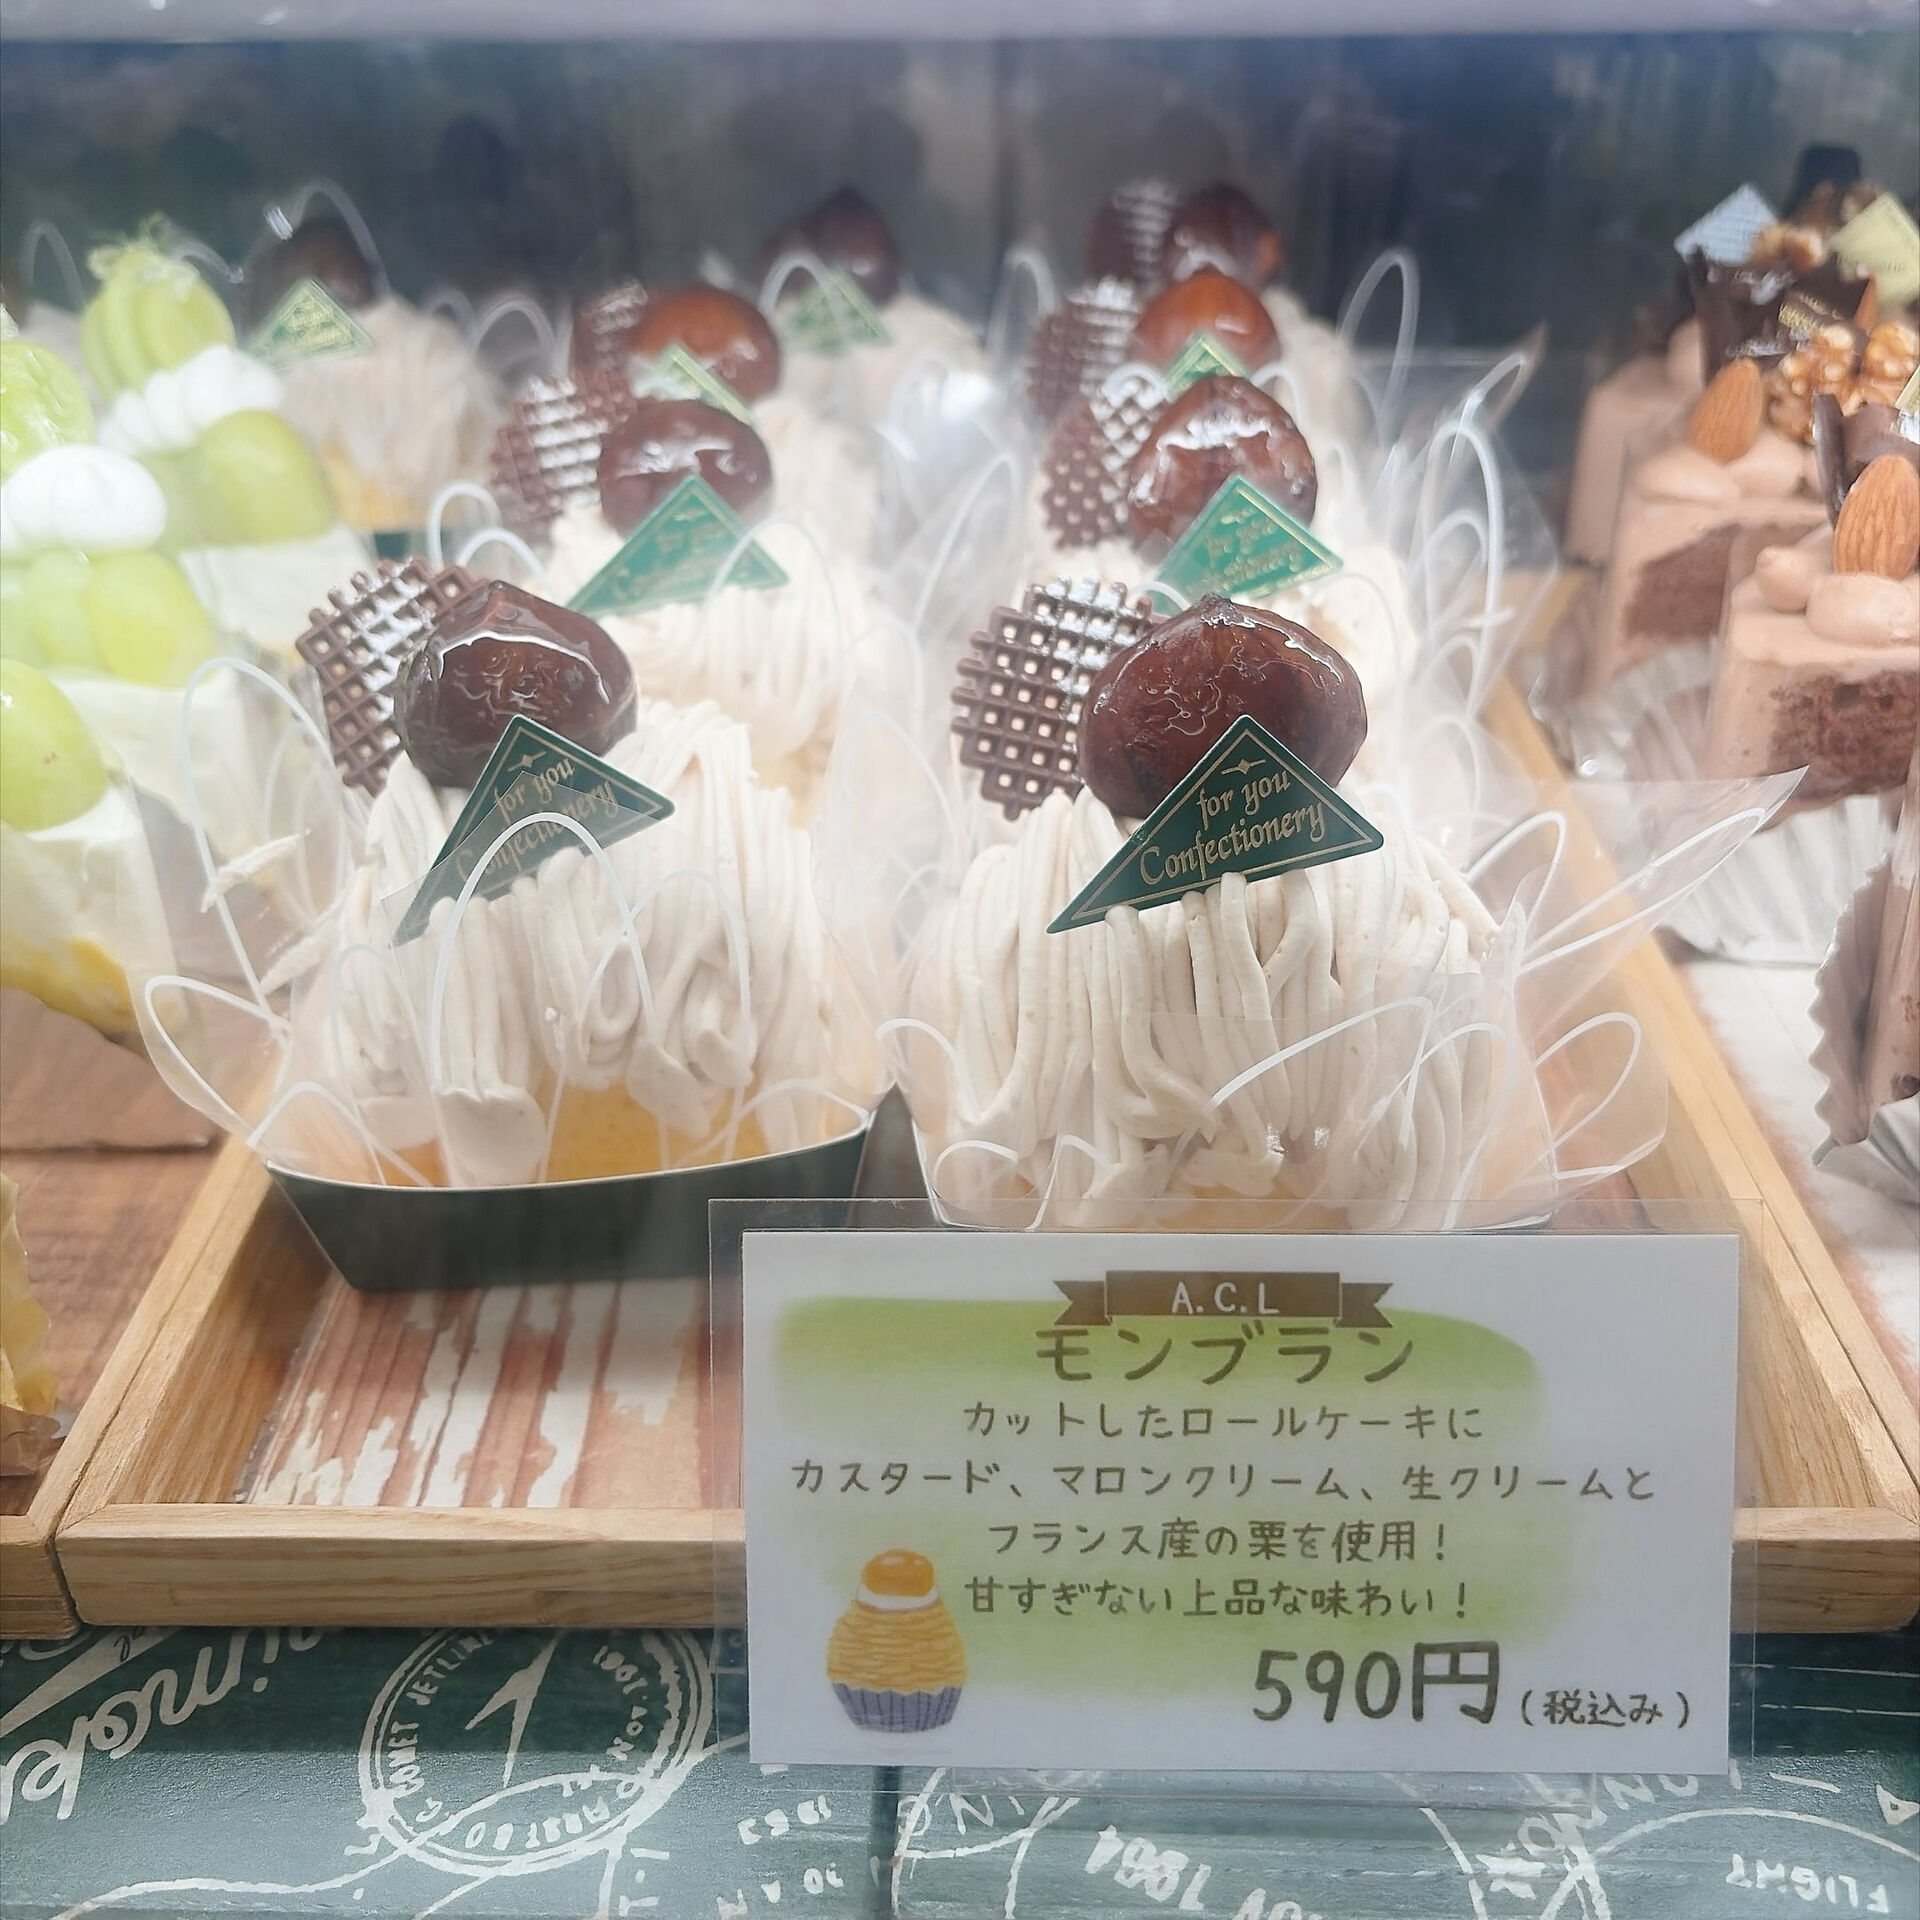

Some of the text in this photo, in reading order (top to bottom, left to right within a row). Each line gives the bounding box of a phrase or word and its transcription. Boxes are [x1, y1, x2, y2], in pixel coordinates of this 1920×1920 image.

[494, 758, 576, 824] for you
[1196, 769, 1292, 831] for you
[1139, 799, 1326, 886] Confectionery
[1172, 1282, 1280, 1315] A.C.L
[1035, 1325, 1414, 1386] モンブラン
[963, 1401, 1483, 1441] カットしたロールケーキに
[791, 1458, 1655, 1502] カスタード、マロンクリーム、生クリームと
[988, 1518, 1448, 1563] フランス産の栗を使用！
[964, 1575, 1467, 1619] 甘すぎない上品な味わい！
[1252, 1640, 1691, 1730] 590円 （税込み）
[1725, 1853, 1890, 1914] FLIGHT
